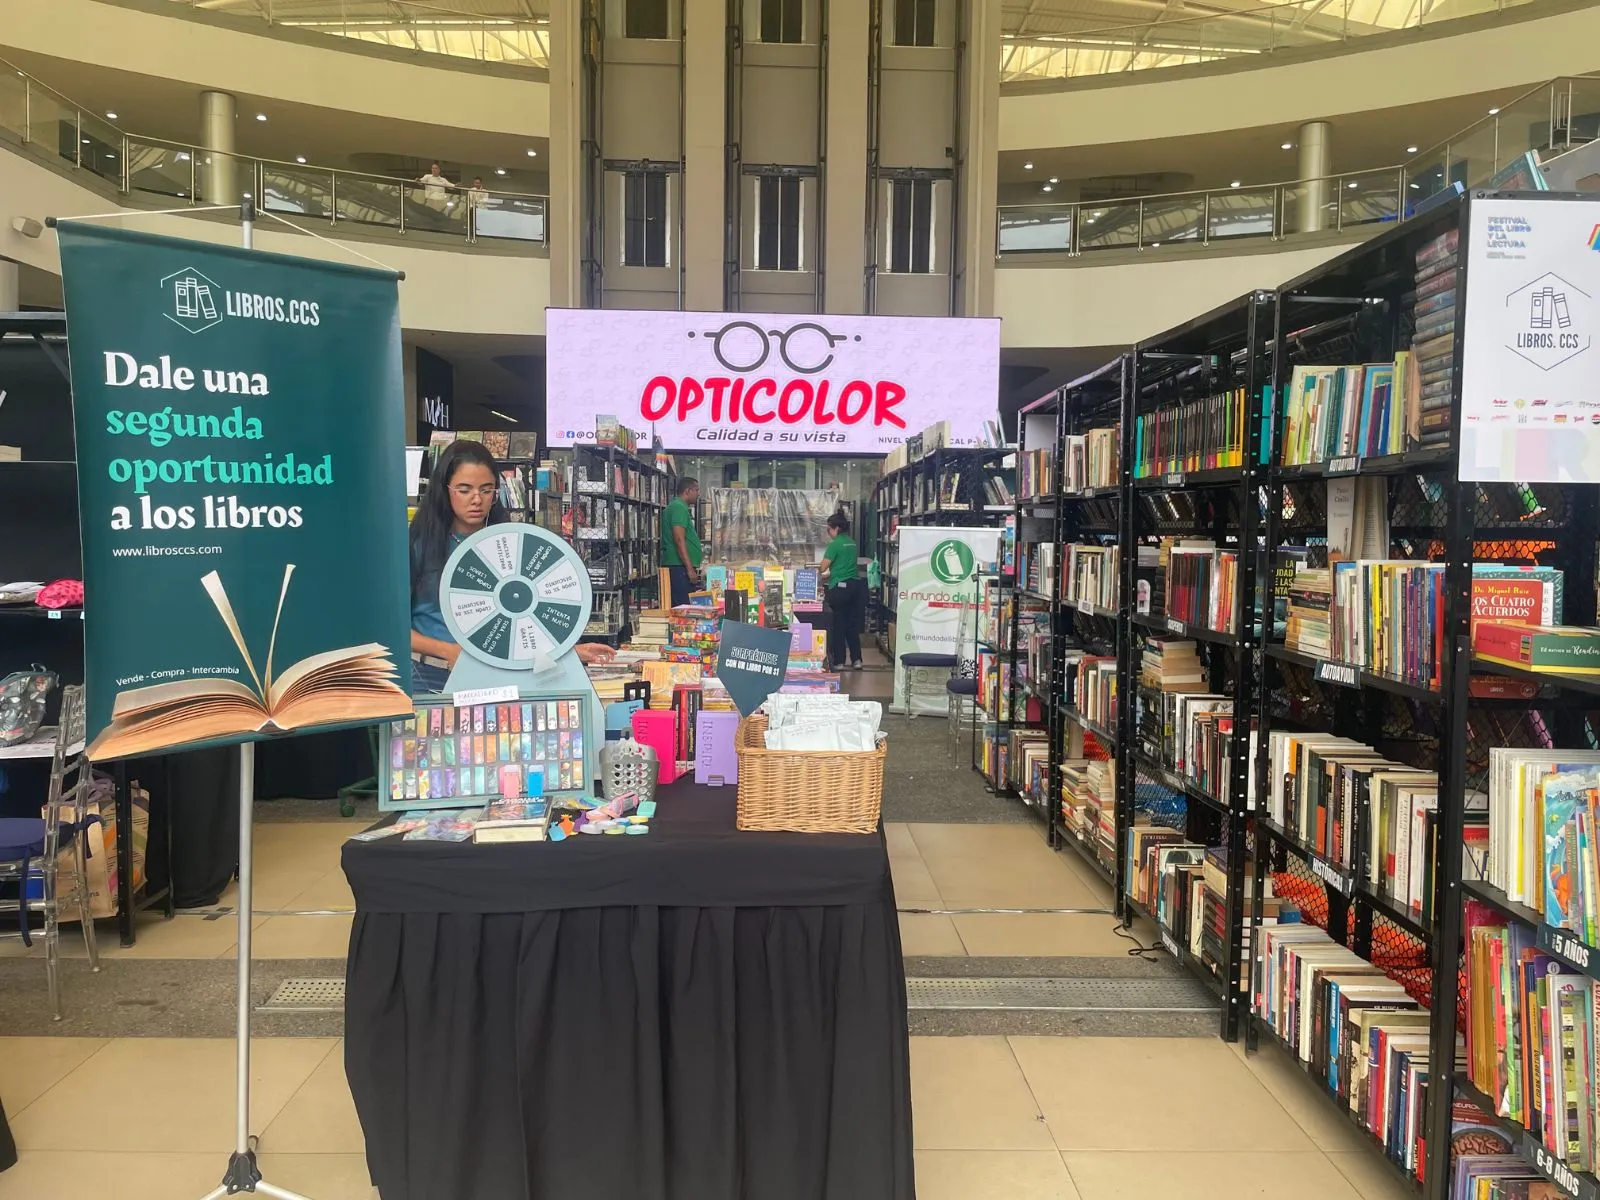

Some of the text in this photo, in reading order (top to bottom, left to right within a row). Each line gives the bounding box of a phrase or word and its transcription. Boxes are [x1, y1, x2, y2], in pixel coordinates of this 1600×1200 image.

[1488, 216, 1528, 224] FESTIVAL
[1487, 240, 1526, 248] LECTURA
[225, 290, 321, 327] LIBROS.CCS
[1559, 334, 1579, 349] CCS
[103, 351, 270, 396] Dale una
[640, 375, 907, 429] OPTICOLOR
[106, 406, 264, 447] segunda
[696, 427, 847, 444] Calidad a su vista
[108, 452, 335, 494] oportunidad
[110, 495, 304, 530] a los libros
[112, 544, 223, 558] www.librosccs.com
[1285, 560, 1294, 568] LA
[899, 590, 908, 600] el
[911, 590, 950, 601] mundo
[1487, 585, 1511, 594] Miguel
[1490, 595, 1535, 607] CUATRO
[1471, 605, 1530, 617] ACUERDOS
[725, 658, 737, 668] CON
[737, 660, 746, 670] UN
[746, 662, 762, 673] LIBRO
[761, 665, 773, 675] POR
[116, 672, 145, 687] Vende
[151, 667, 186, 681] Compra
[192, 666, 240, 677] Intercambia
[1564, 938, 1590, 968] AÑOS
[1536, 1148, 1580, 1197] 6-8 AÑOS
